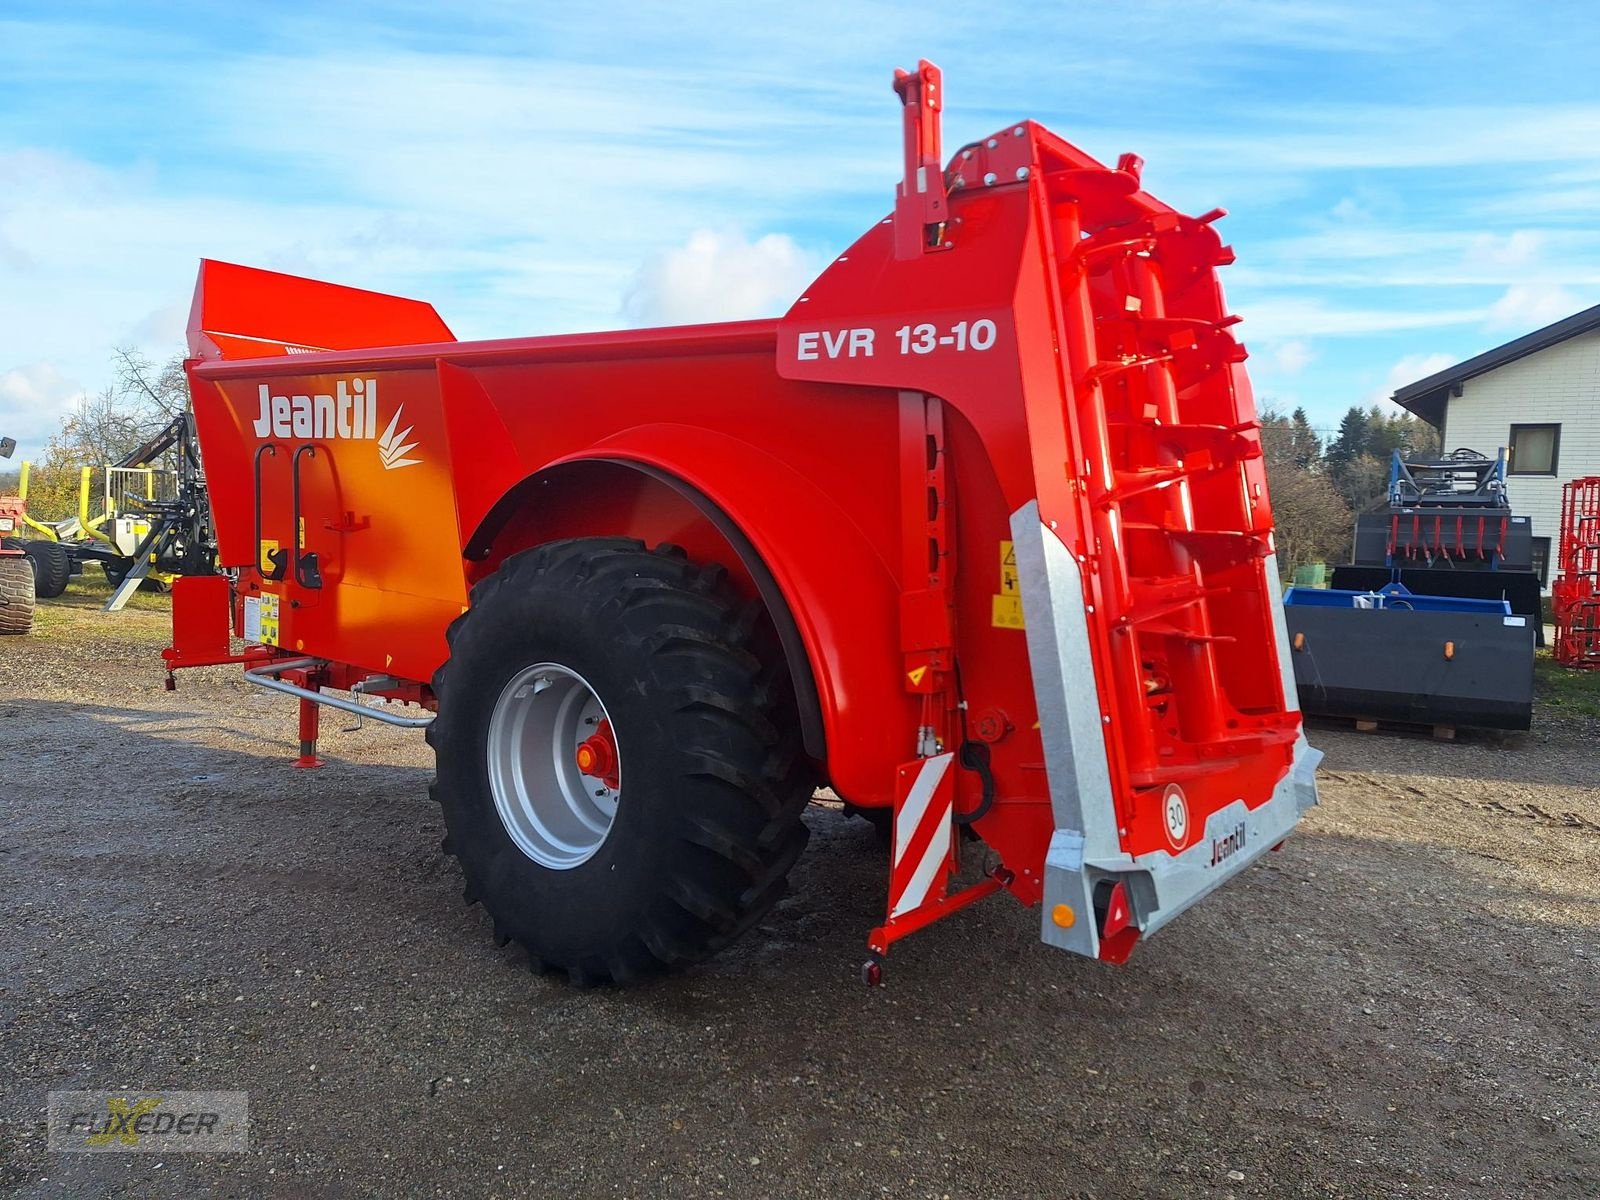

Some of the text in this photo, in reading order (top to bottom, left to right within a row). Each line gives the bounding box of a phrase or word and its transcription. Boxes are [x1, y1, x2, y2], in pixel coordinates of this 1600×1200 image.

[798, 319, 997, 361] EVR 13-10
[253, 377, 377, 439] Jeantil
[1168, 803, 1184, 830] 30
[1211, 821, 1246, 867] Jeantil
